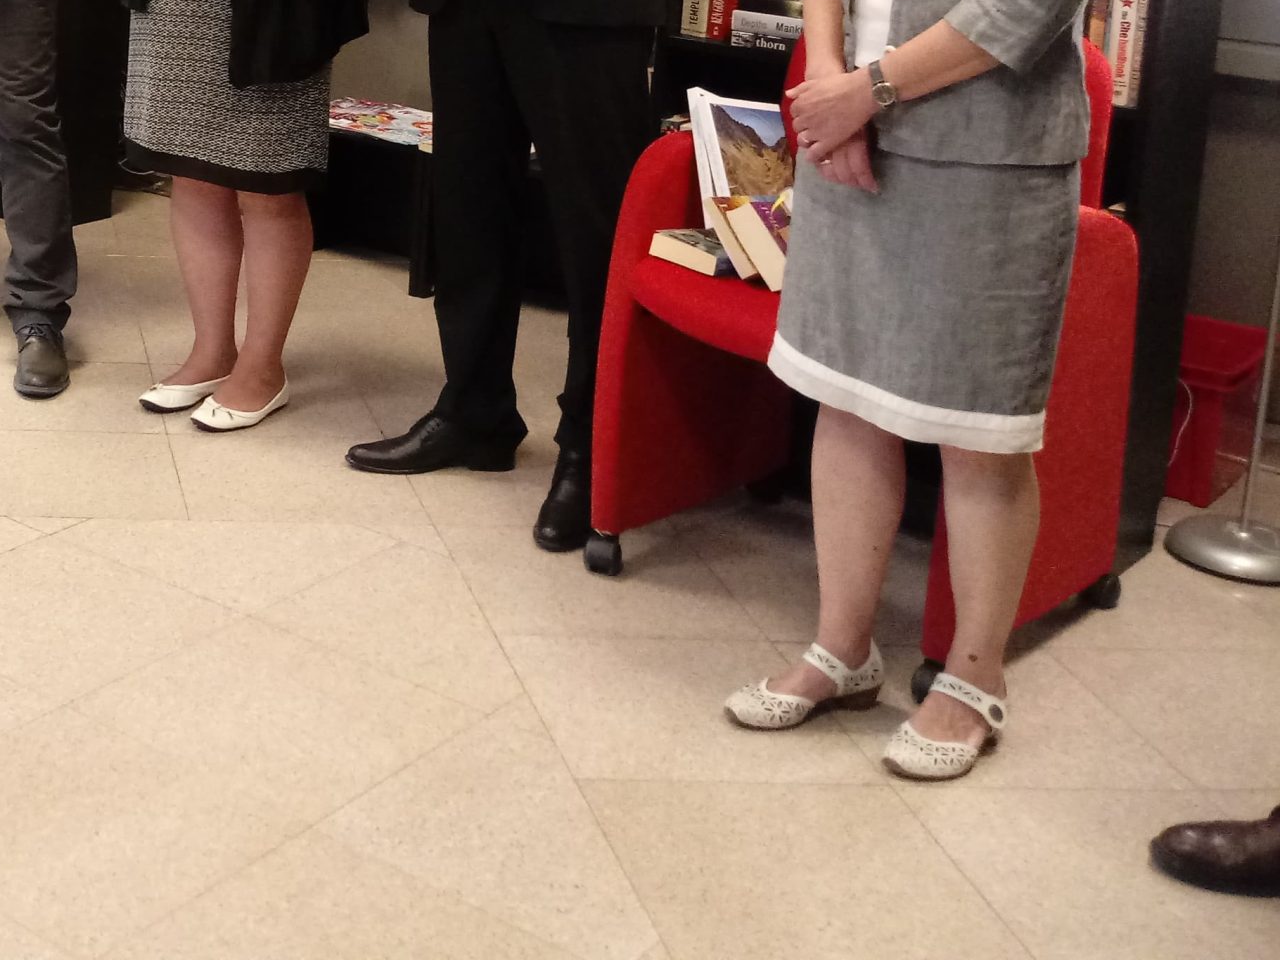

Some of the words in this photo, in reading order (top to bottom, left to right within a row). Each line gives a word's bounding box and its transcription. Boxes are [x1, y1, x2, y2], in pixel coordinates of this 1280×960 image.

[776, 22, 803, 35] Mank
[1119, 22, 1131, 38] Che
[755, 39, 786, 51] thorn
